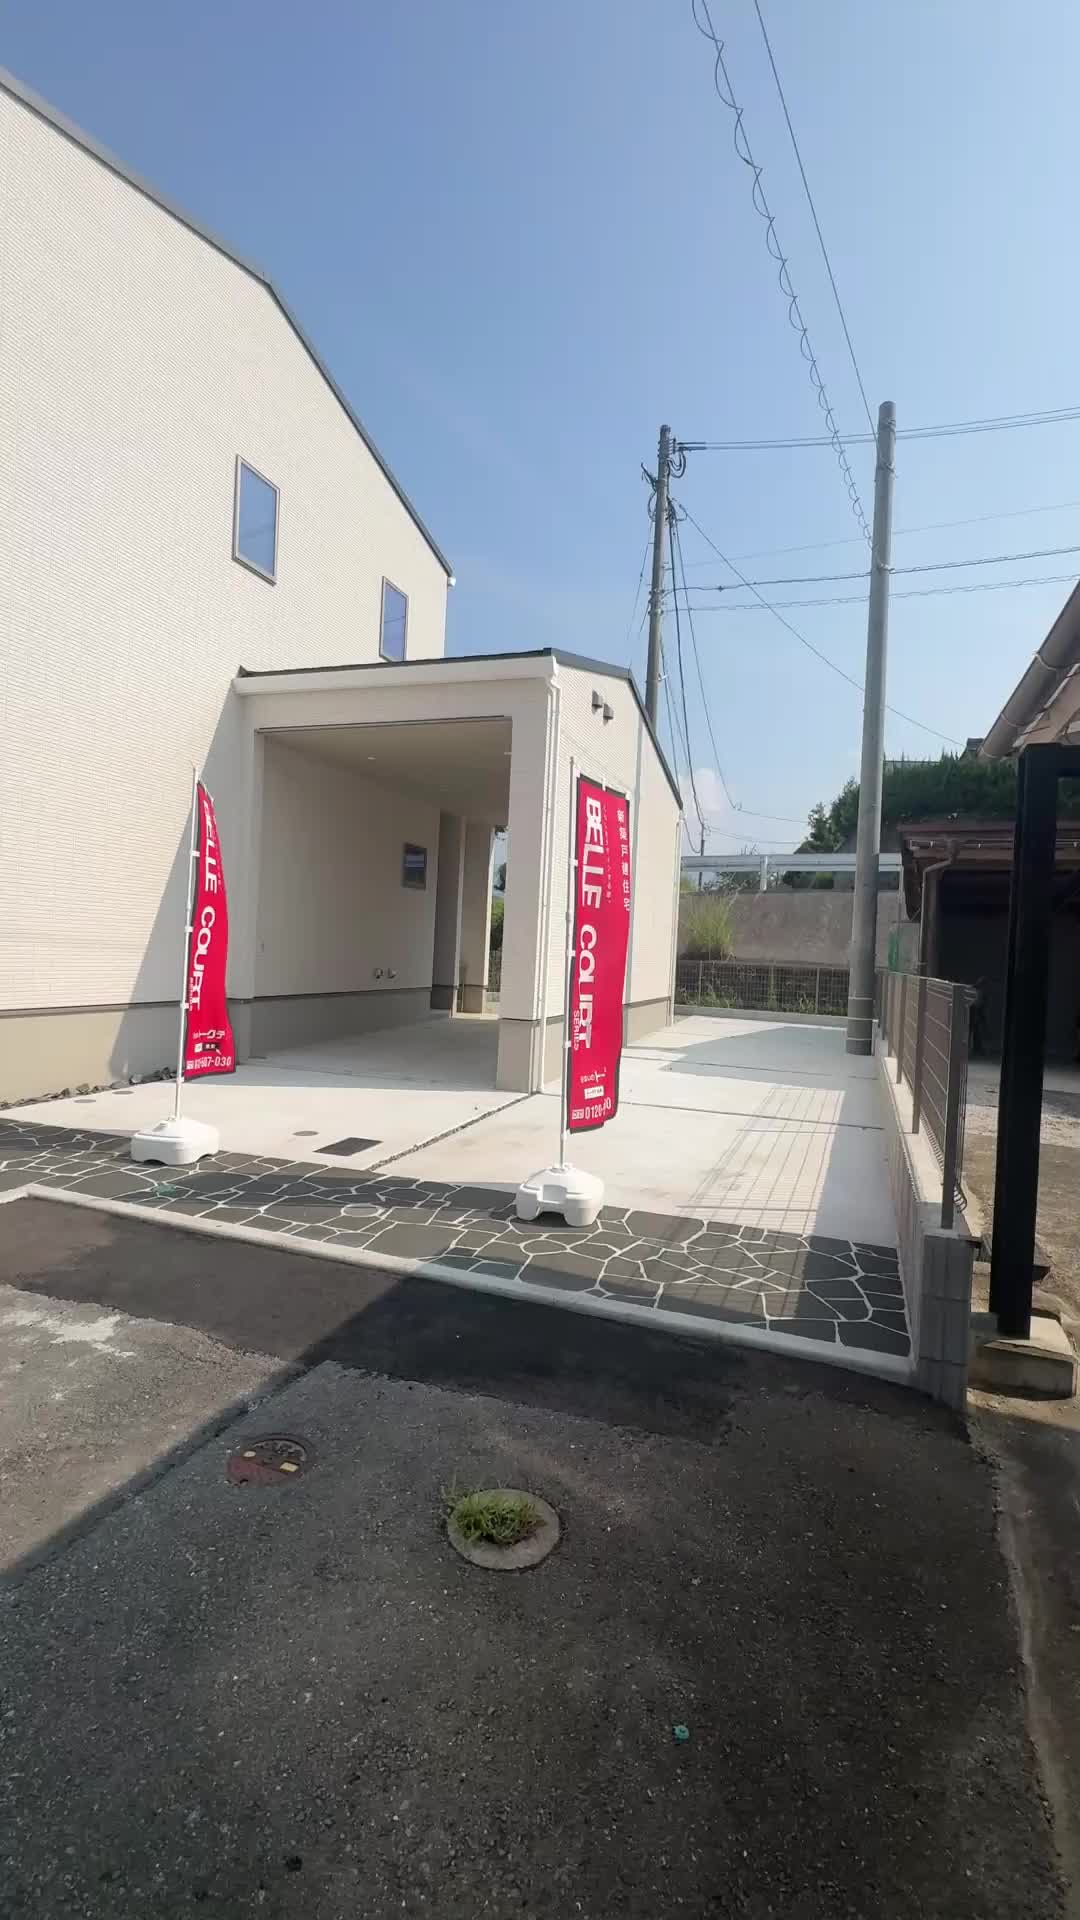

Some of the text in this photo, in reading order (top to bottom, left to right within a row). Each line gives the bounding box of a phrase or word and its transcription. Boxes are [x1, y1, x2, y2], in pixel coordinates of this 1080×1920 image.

[192, 906, 215, 1010] COURT
[578, 797, 605, 1049] BELLE COURT
